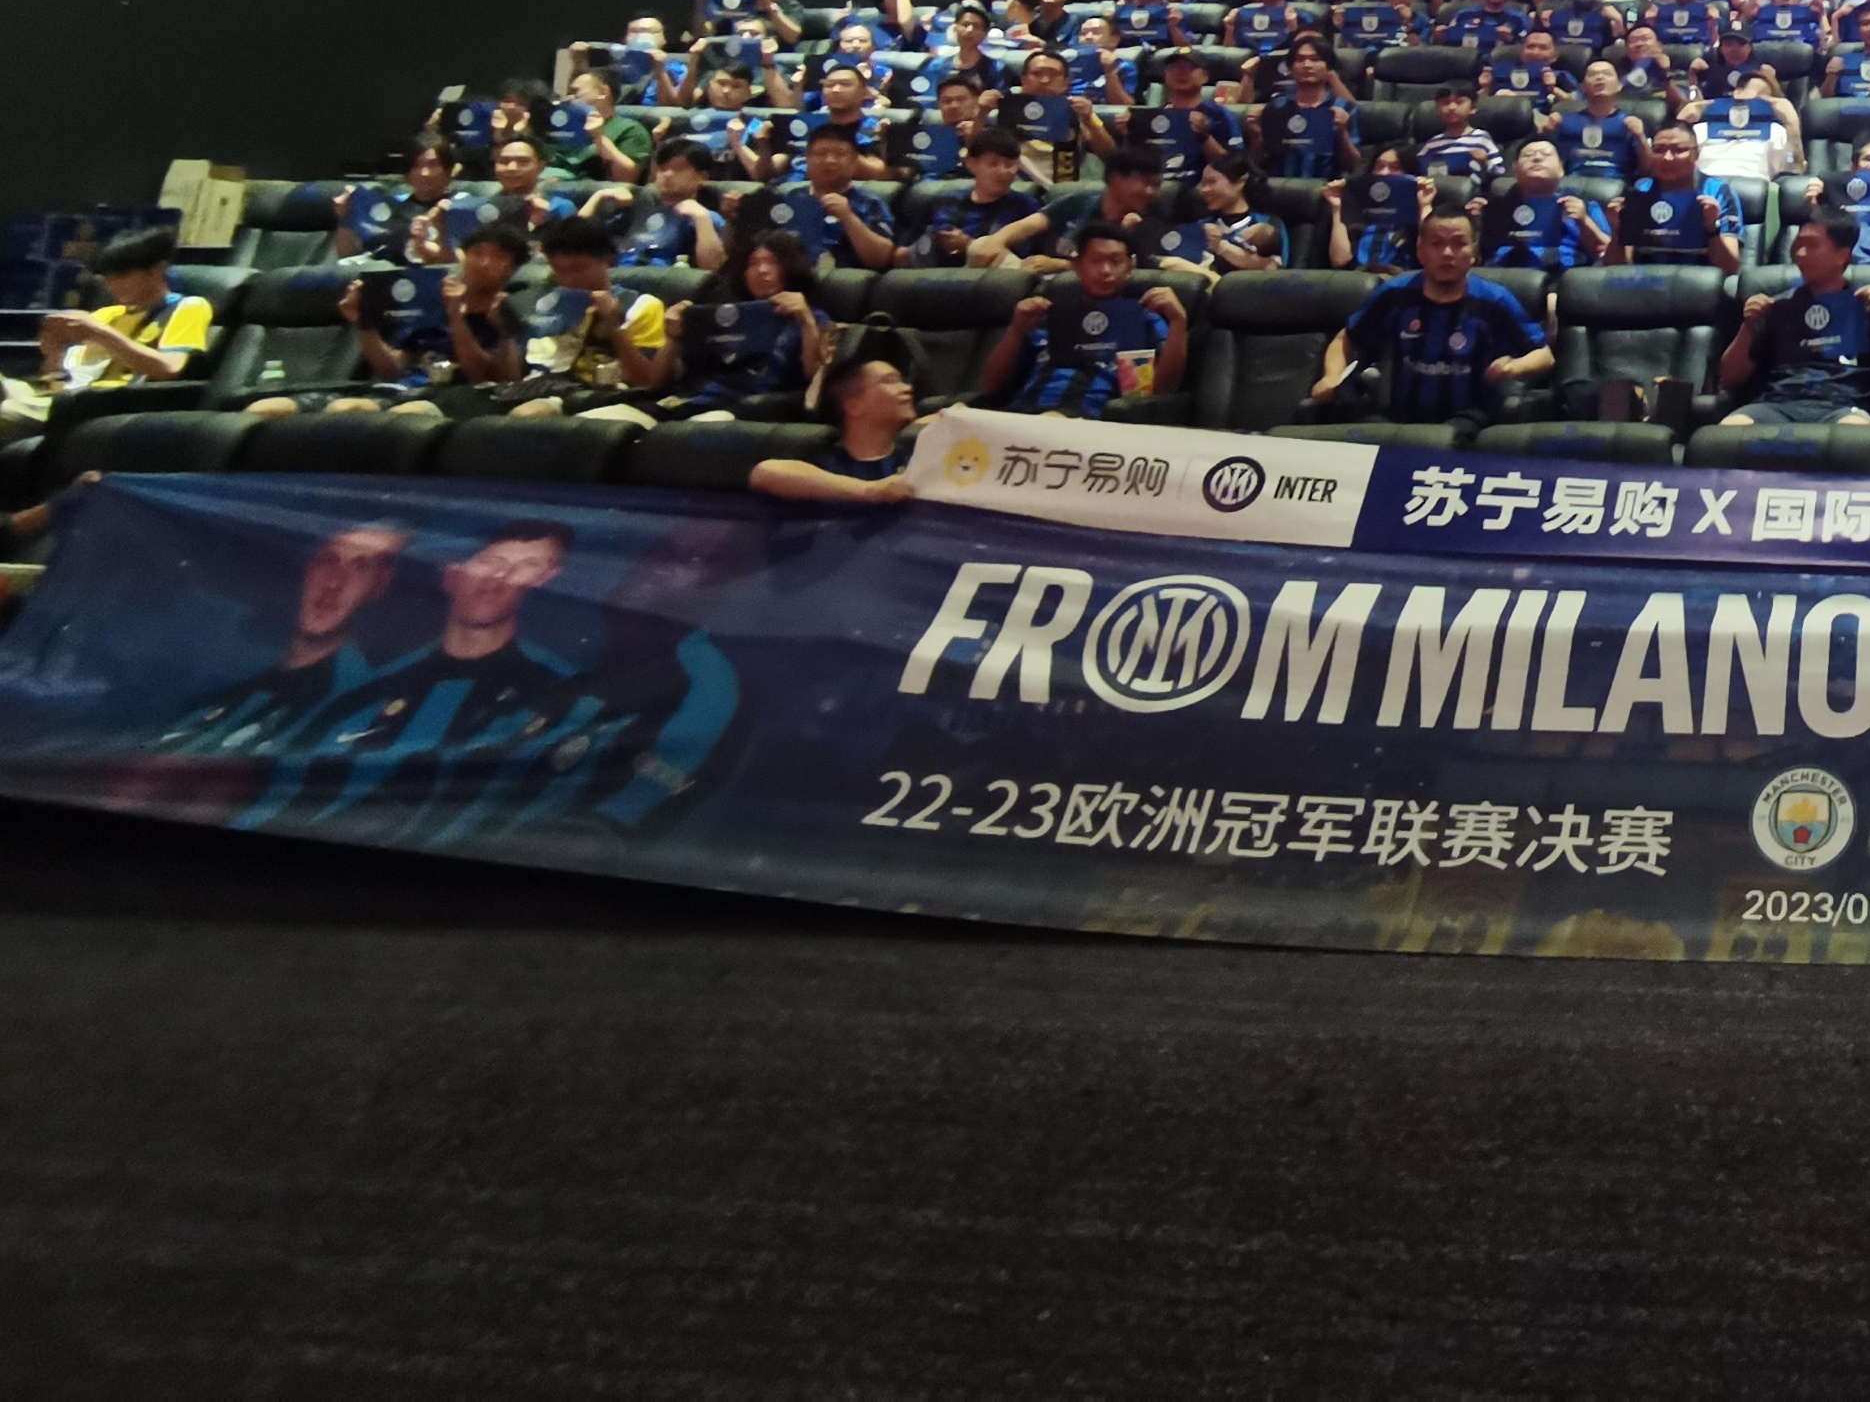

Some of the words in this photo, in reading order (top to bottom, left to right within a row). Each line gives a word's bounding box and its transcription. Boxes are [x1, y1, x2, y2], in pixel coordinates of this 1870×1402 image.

[997, 444, 1170, 497] 苏宁易购
[1274, 475, 1338, 504] INTER
[1402, 465, 1679, 538] 苏宁易购
[1761, 770, 1848, 807] MANCHESTER
[861, 770, 1674, 877] 22-23欧洲冠军联赛决赛
[1784, 854, 1817, 867] CITY
